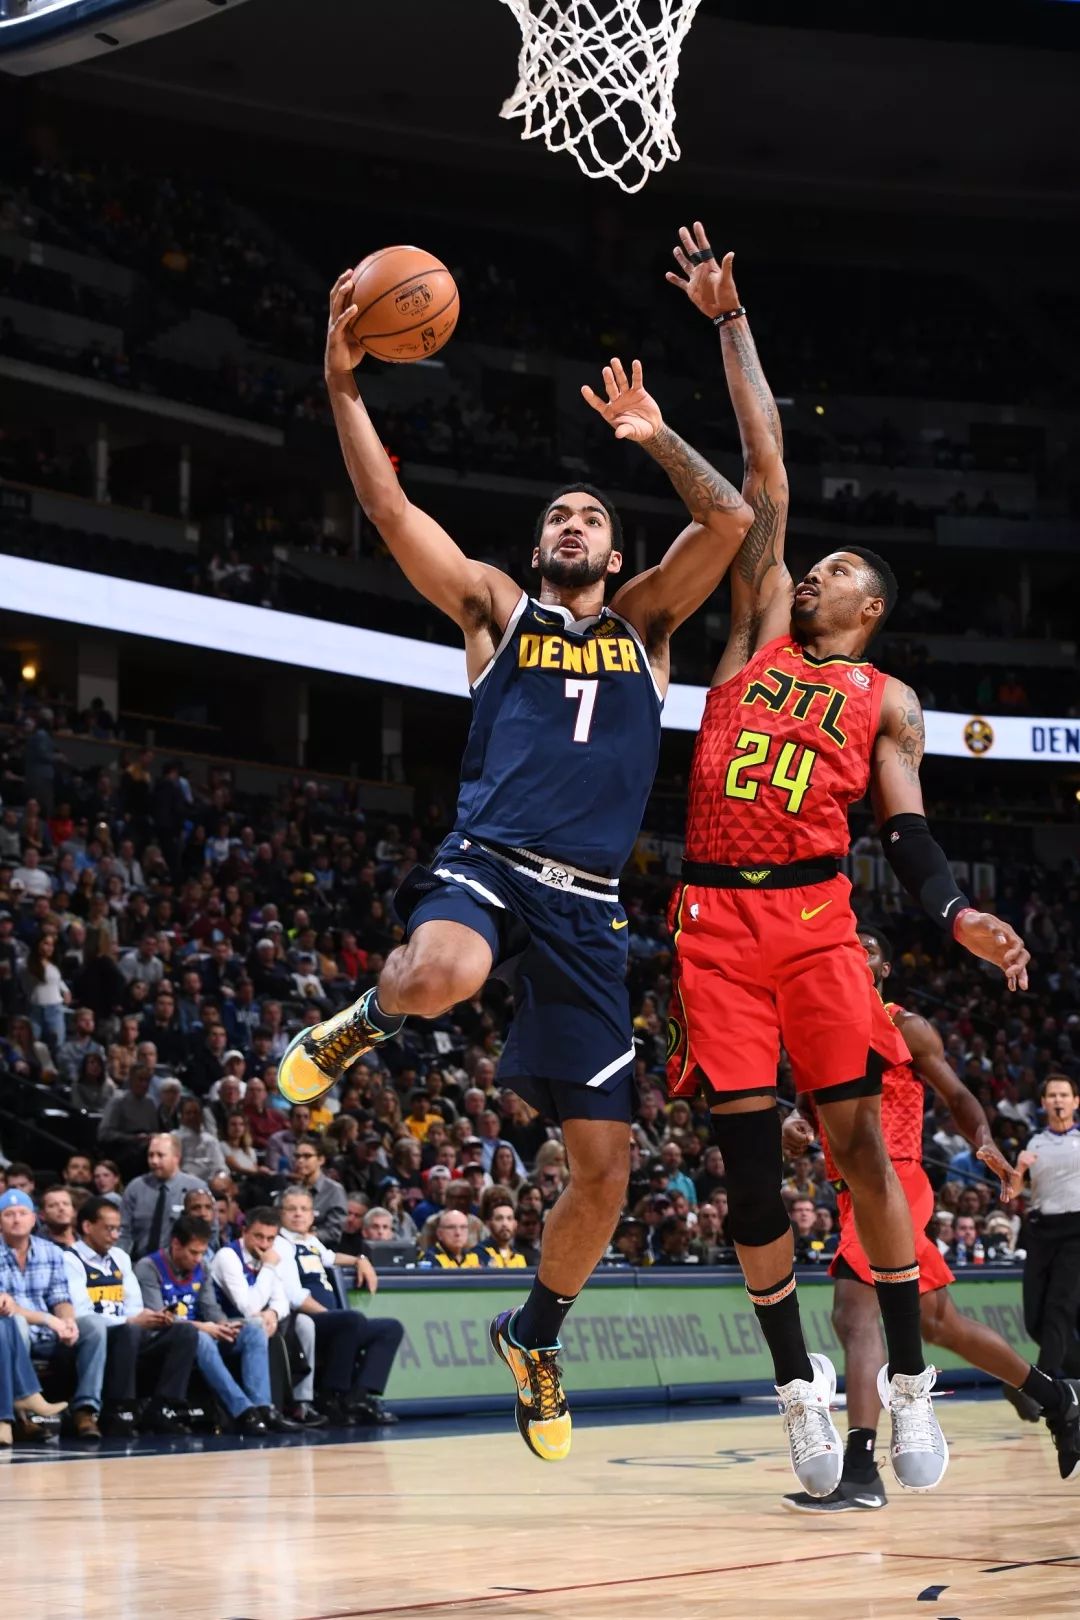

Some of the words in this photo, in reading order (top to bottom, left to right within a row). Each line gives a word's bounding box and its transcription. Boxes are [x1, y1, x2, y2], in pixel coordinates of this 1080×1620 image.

[518, 633, 641, 674] DENVER
[564, 678, 599, 743] 7
[740, 667, 848, 750] ATL
[1031, 726, 1080, 754] DEN
[724, 728, 812, 815] 24
[559, 1313, 720, 1363] EFRESHING,
